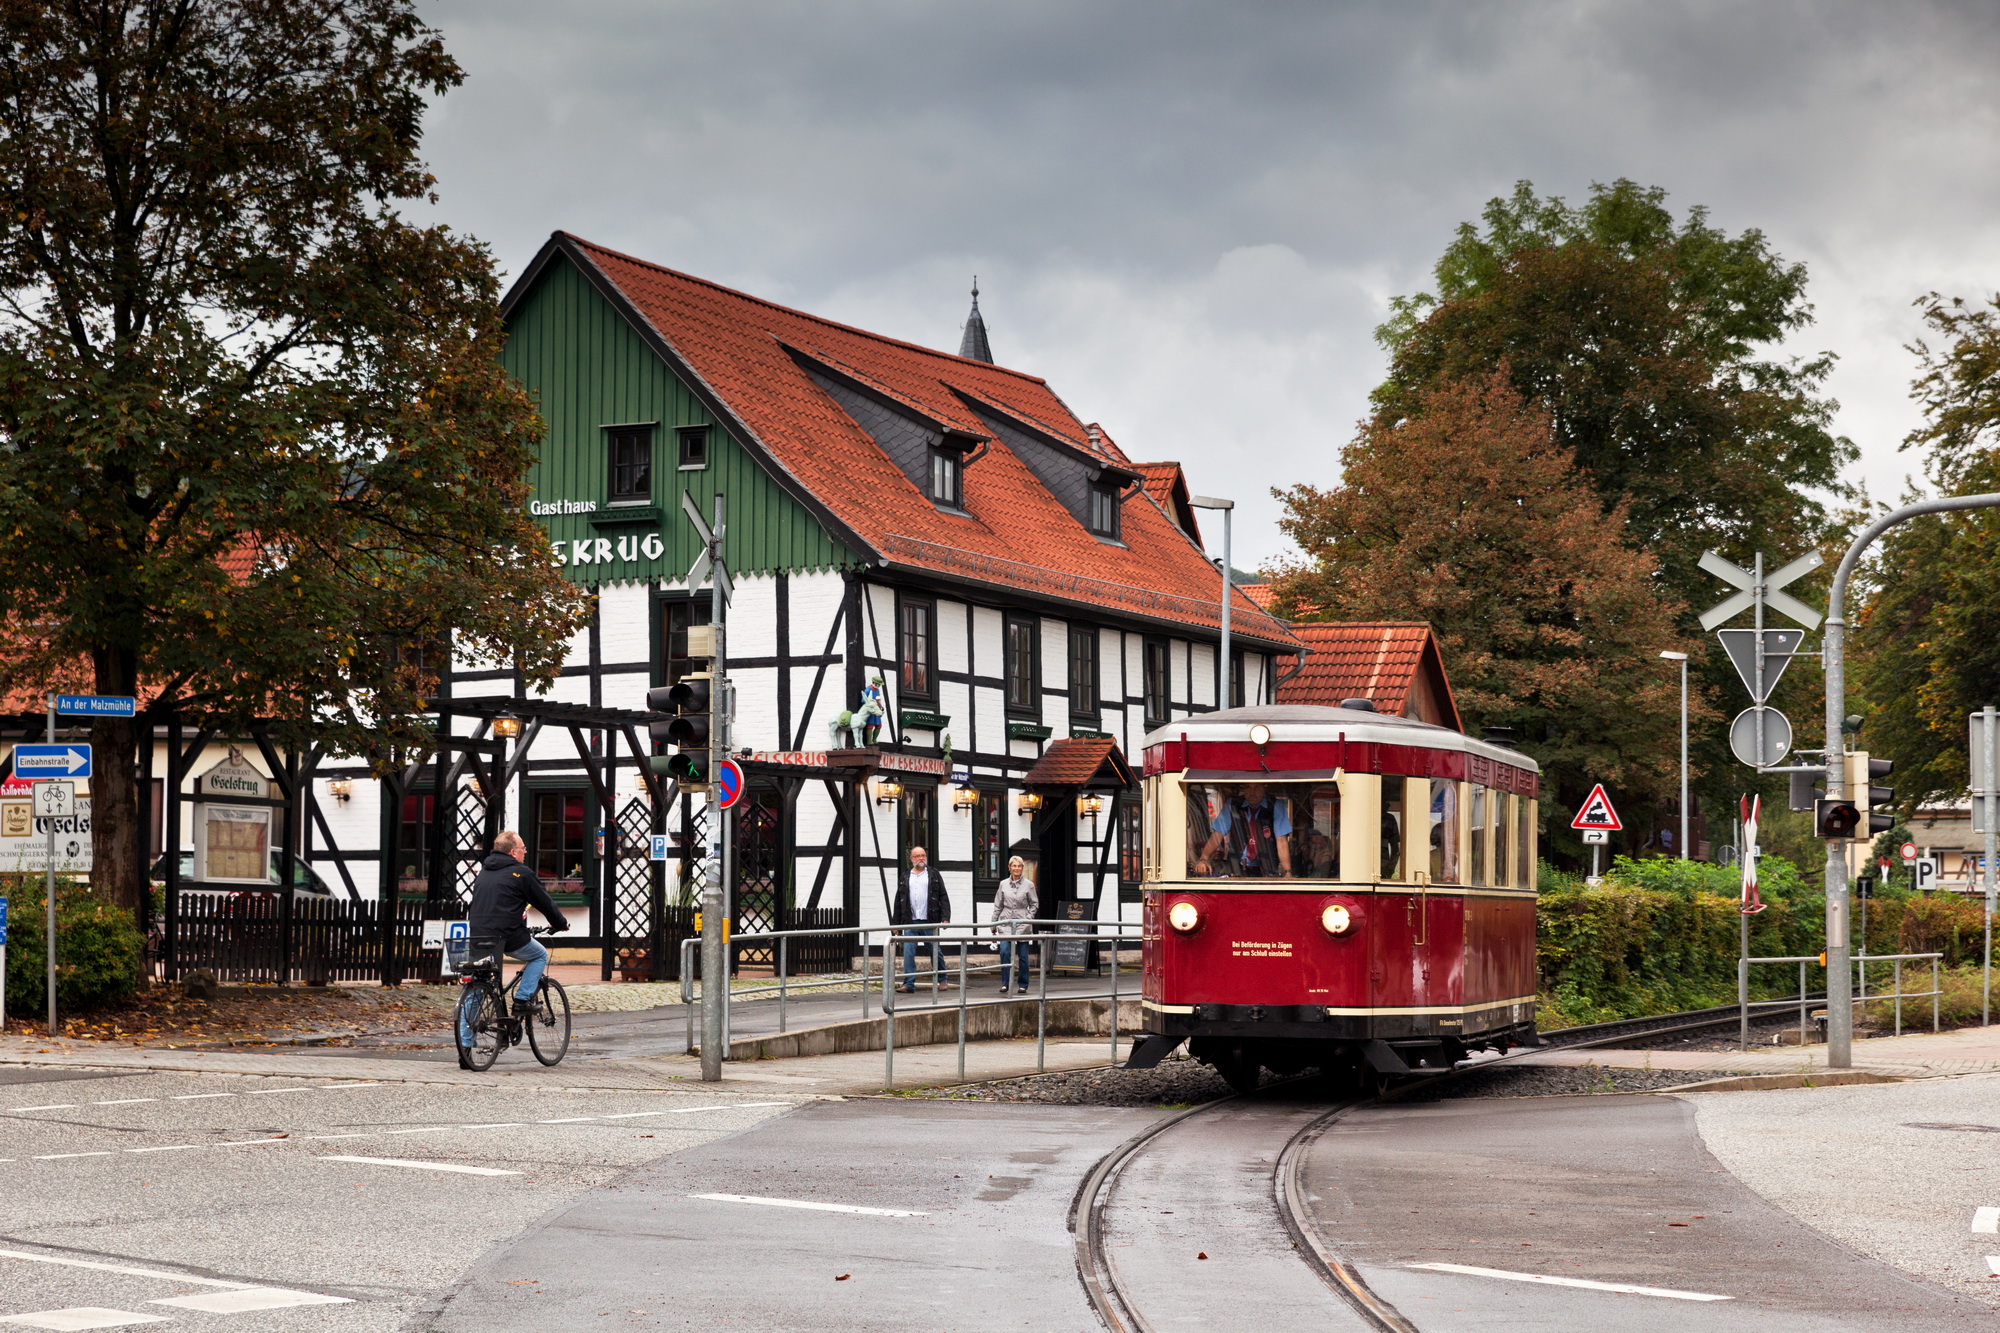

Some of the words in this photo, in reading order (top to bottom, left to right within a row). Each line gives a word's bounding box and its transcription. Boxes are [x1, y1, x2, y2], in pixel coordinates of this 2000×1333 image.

[530, 499, 597, 516] Gasthaus
[61, 699, 71, 709] An
[74, 699, 87, 710] der
[90, 699, 131, 711] Malzmühle
[20, 757, 70, 766] Einbahnstraße
[898, 757, 945, 773] ESELSKRUG
[220, 767, 251, 776] RESTAURANT
[210, 774, 258, 795] Eselskrug
[656, 838, 664, 851] P
[1919, 862, 1933, 886] P
[1241, 941, 1270, 950] Beförderung
